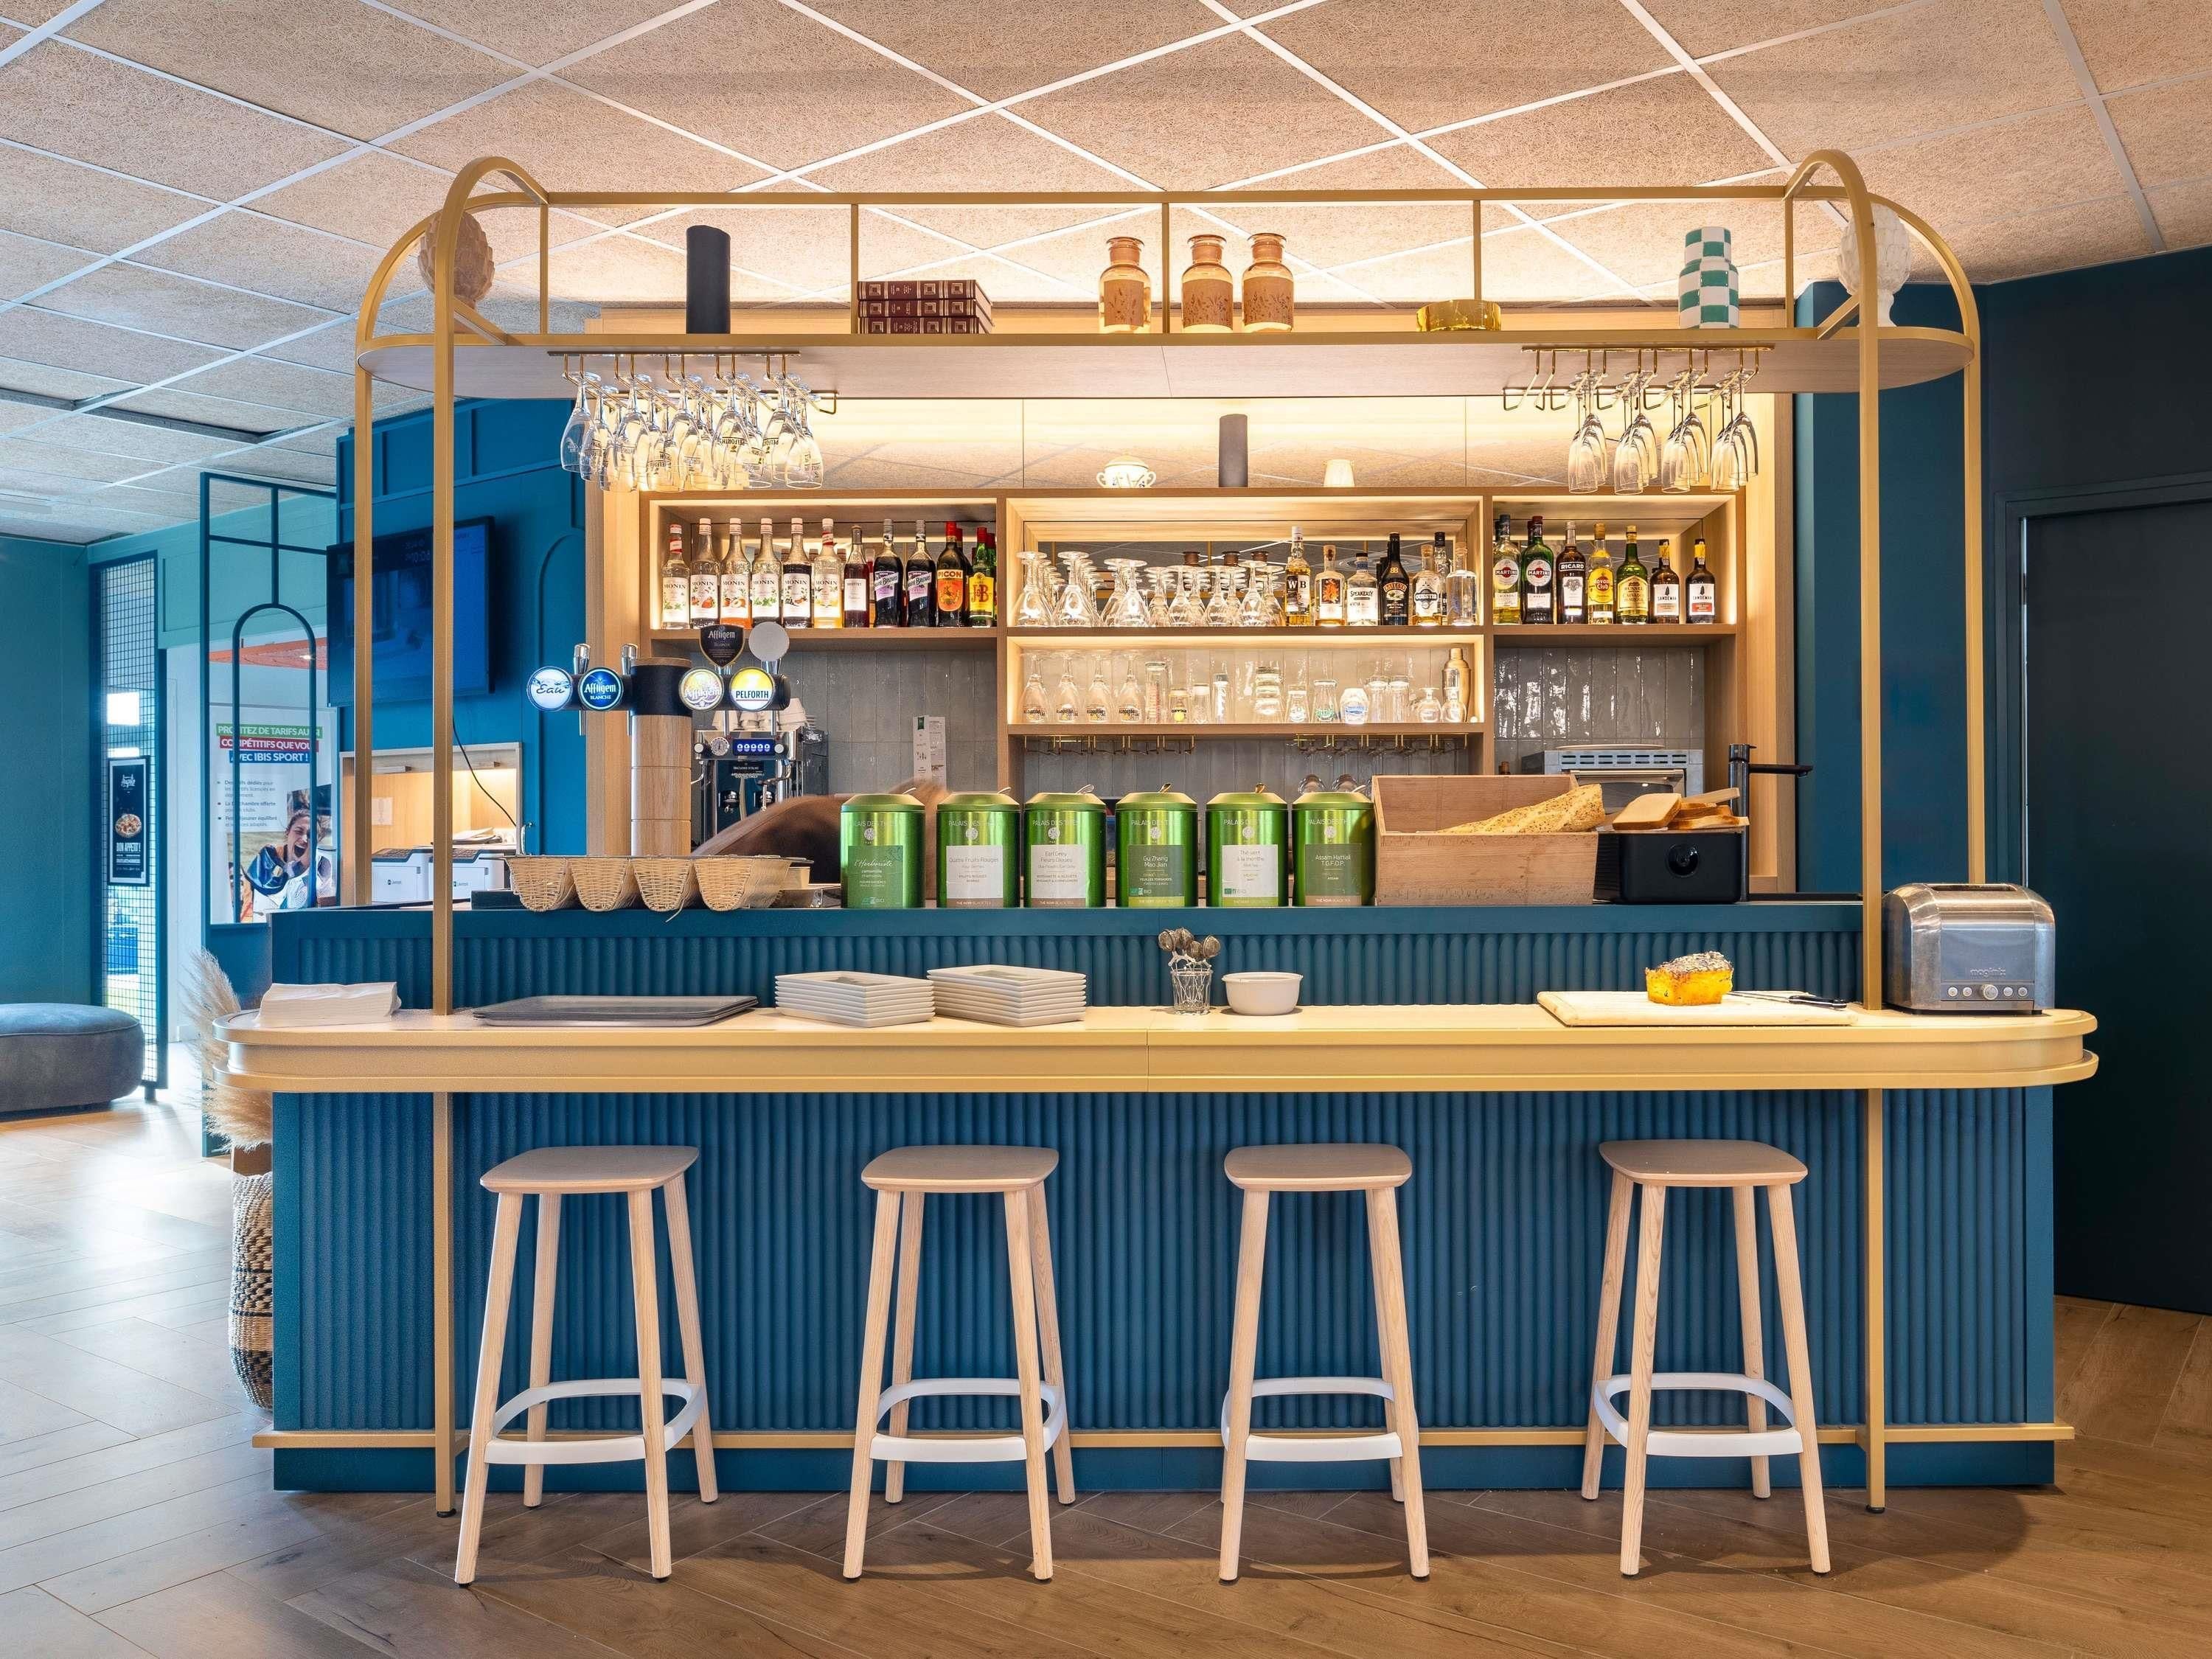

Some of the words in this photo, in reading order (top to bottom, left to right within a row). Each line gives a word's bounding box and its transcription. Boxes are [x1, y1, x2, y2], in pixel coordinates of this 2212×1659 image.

[708, 630, 735, 640] Affligem
[536, 684, 565, 694] Eau
[584, 683, 616, 694] Affligem
[736, 690, 769, 698] PELFORTH
[218, 726, 257, 734] PROITEZ
[258, 727, 269, 735] DE
[221, 738, 275, 748] COPÉTITIFS
[276, 741, 296, 750] QUE
[254, 753, 271, 761] IBIS
[273, 753, 303, 762] SPORT
